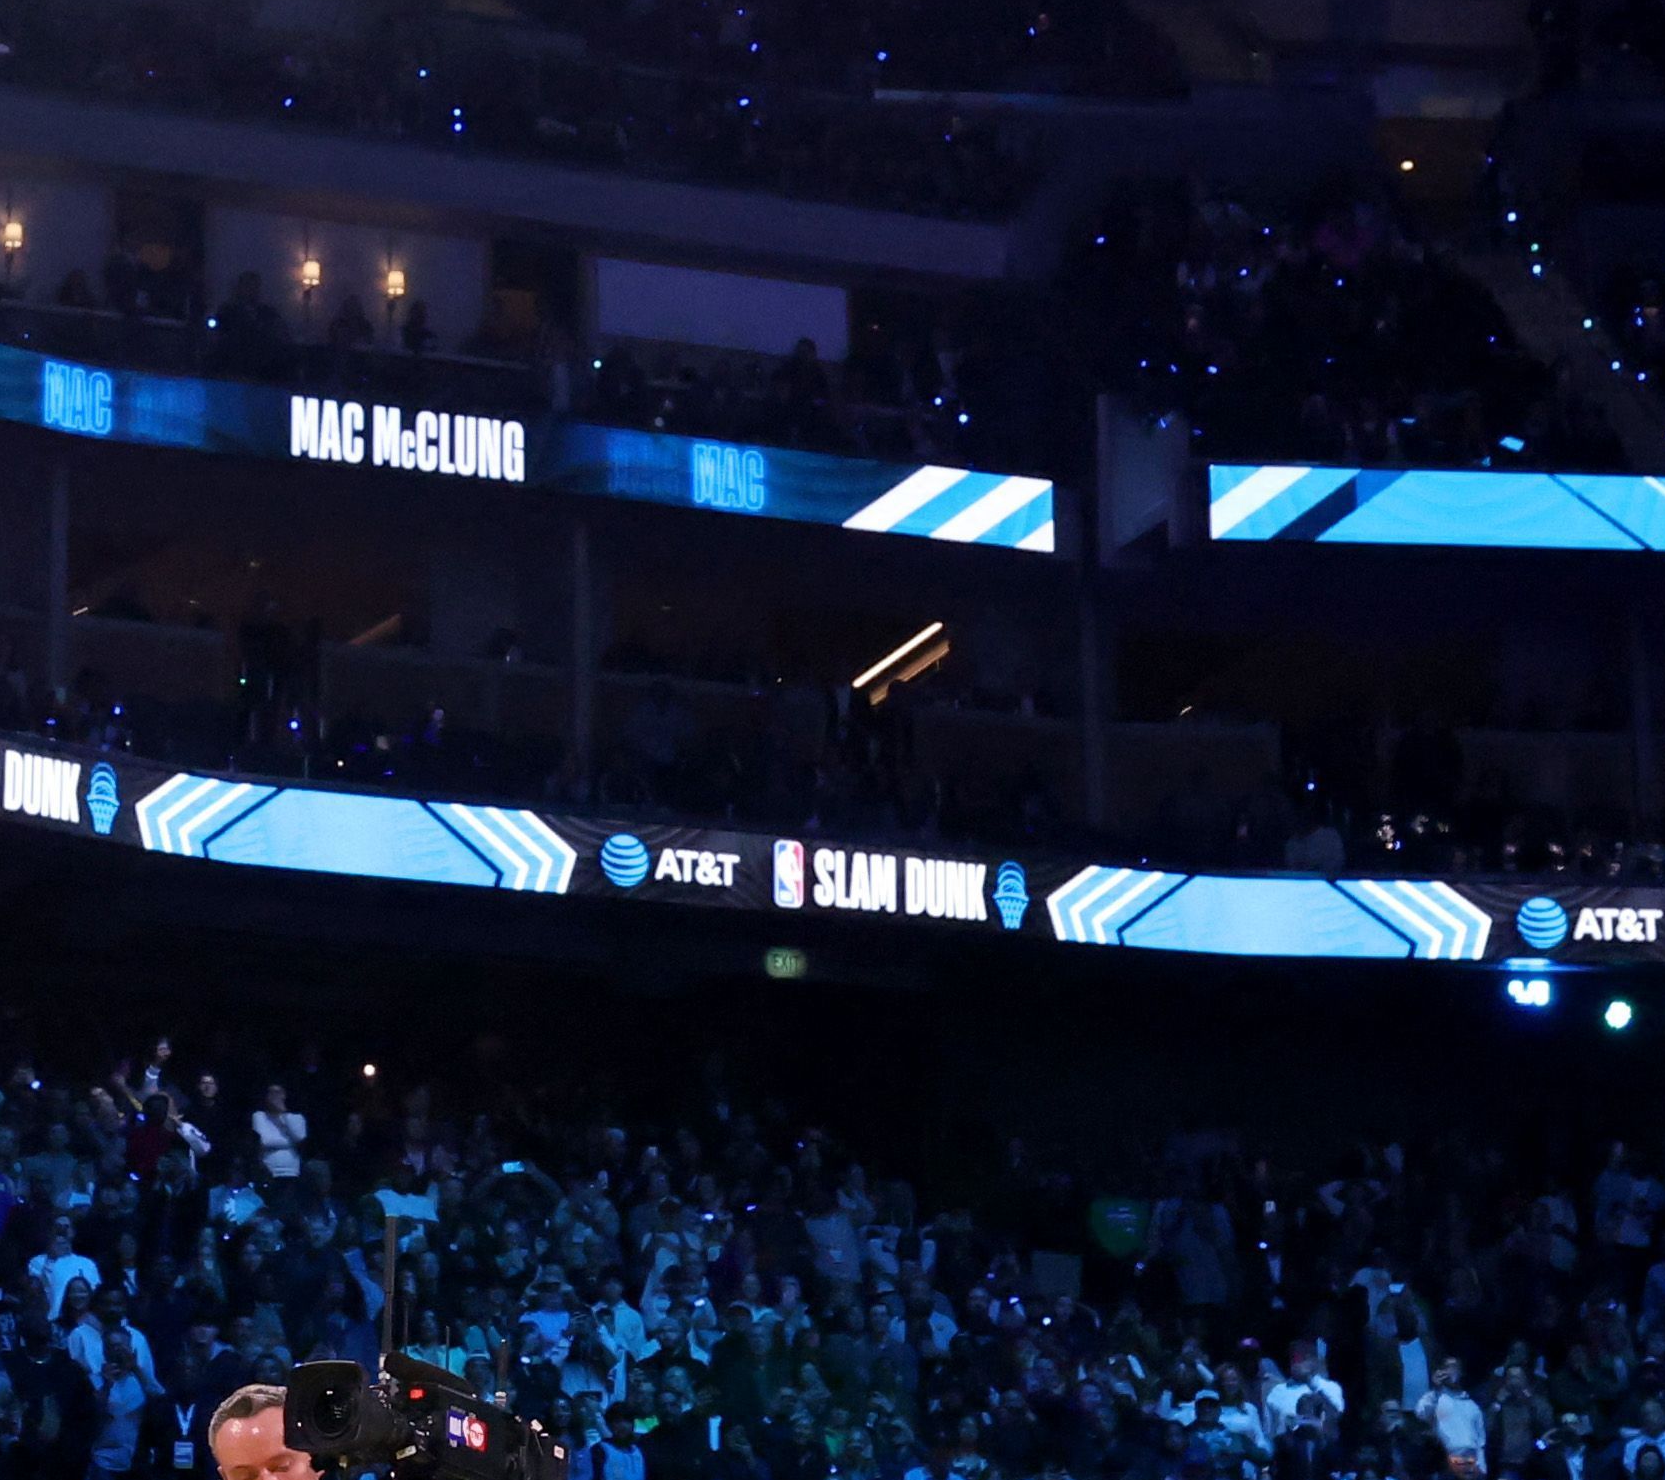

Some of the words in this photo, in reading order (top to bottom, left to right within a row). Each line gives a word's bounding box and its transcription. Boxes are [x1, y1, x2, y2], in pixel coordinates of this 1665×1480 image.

[43, 359, 114, 434] MAC
[290, 394, 366, 466] MAC
[373, 409, 526, 483] McCLUNG
[691, 442, 766, 512] MAC
[4, 749, 81, 824] DUNK
[655, 847, 741, 888] AT&T
[812, 847, 898, 915] SLAM
[904, 856, 988, 922] DUNK
[1573, 906, 1663, 943] AT&T
